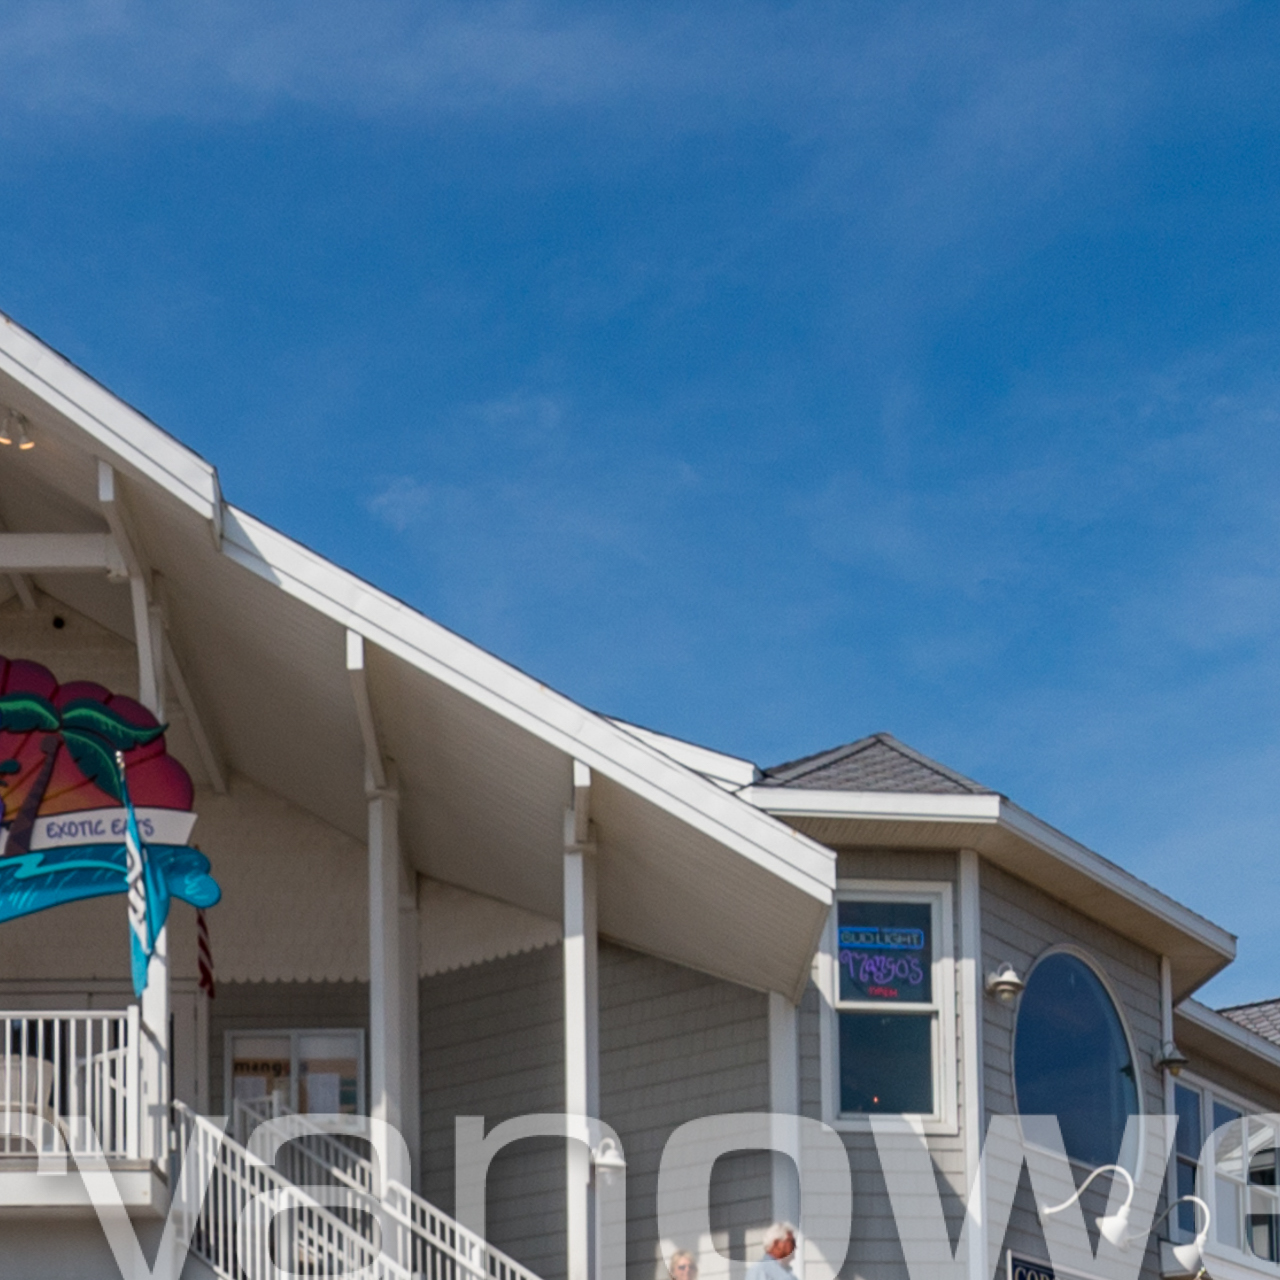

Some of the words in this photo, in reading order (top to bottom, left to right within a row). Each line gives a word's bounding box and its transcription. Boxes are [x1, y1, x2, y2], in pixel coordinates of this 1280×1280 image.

[46, 820, 106, 839] EXOTIC
[841, 930, 876, 944] BUD
[876, 931, 919, 946] LIGHT
